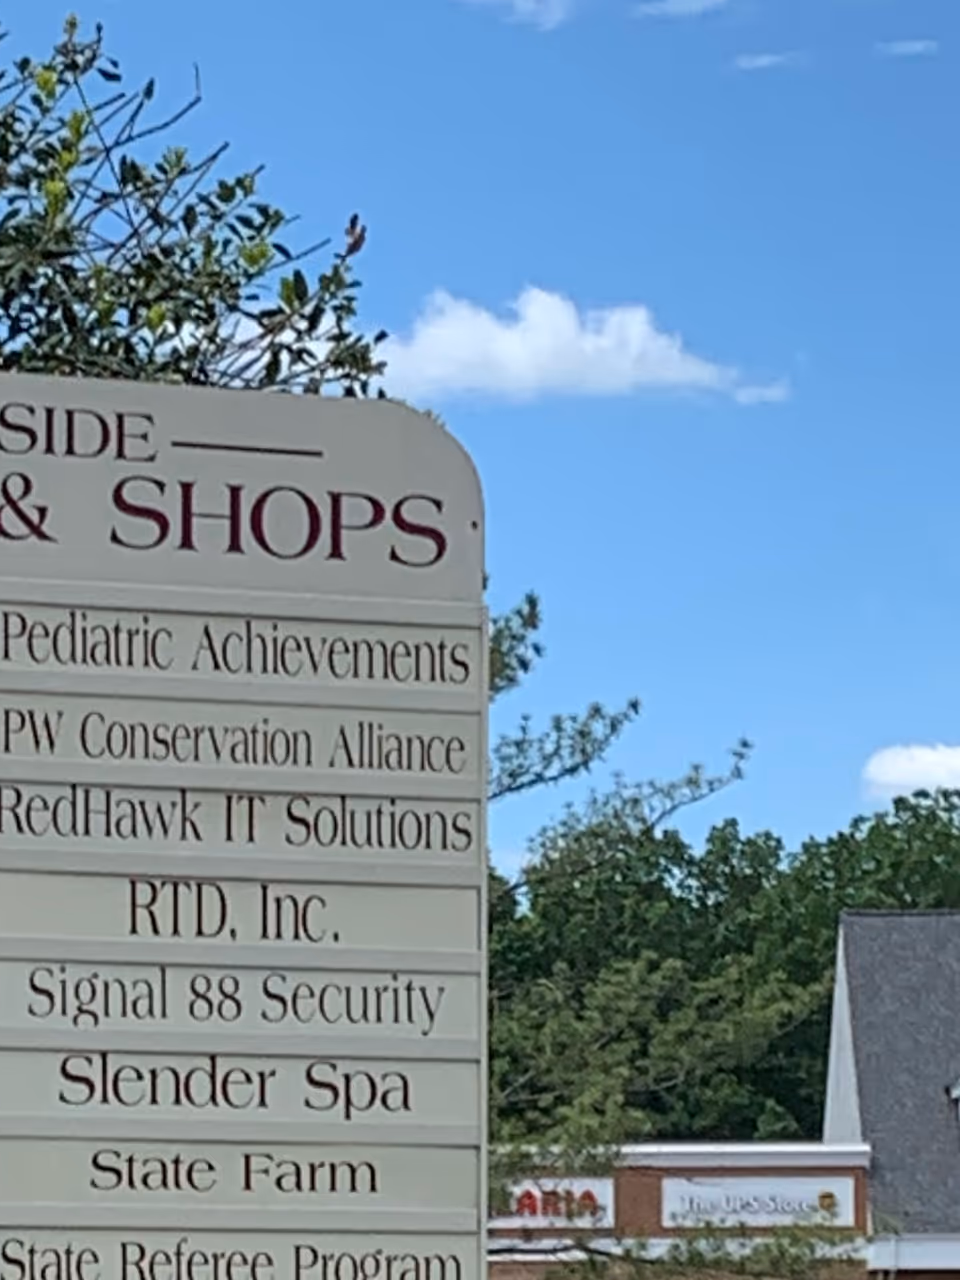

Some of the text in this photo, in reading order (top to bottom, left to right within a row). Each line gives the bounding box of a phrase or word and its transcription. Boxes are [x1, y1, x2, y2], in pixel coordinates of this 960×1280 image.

[110, 475, 448, 568] SHOPS
[1, 610, 471, 684] Pediatric Achievements
[2, 708, 465, 774] PW Conservation Alliance
[225, 794, 265, 844] IT
[284, 795, 473, 852] Solutions
[129, 878, 340, 943] RTD, Inc.
[28, 965, 445, 1036] Signal 88 Security
[58, 1051, 412, 1120] Slender Spa
[90, 1149, 378, 1193] State Farm
